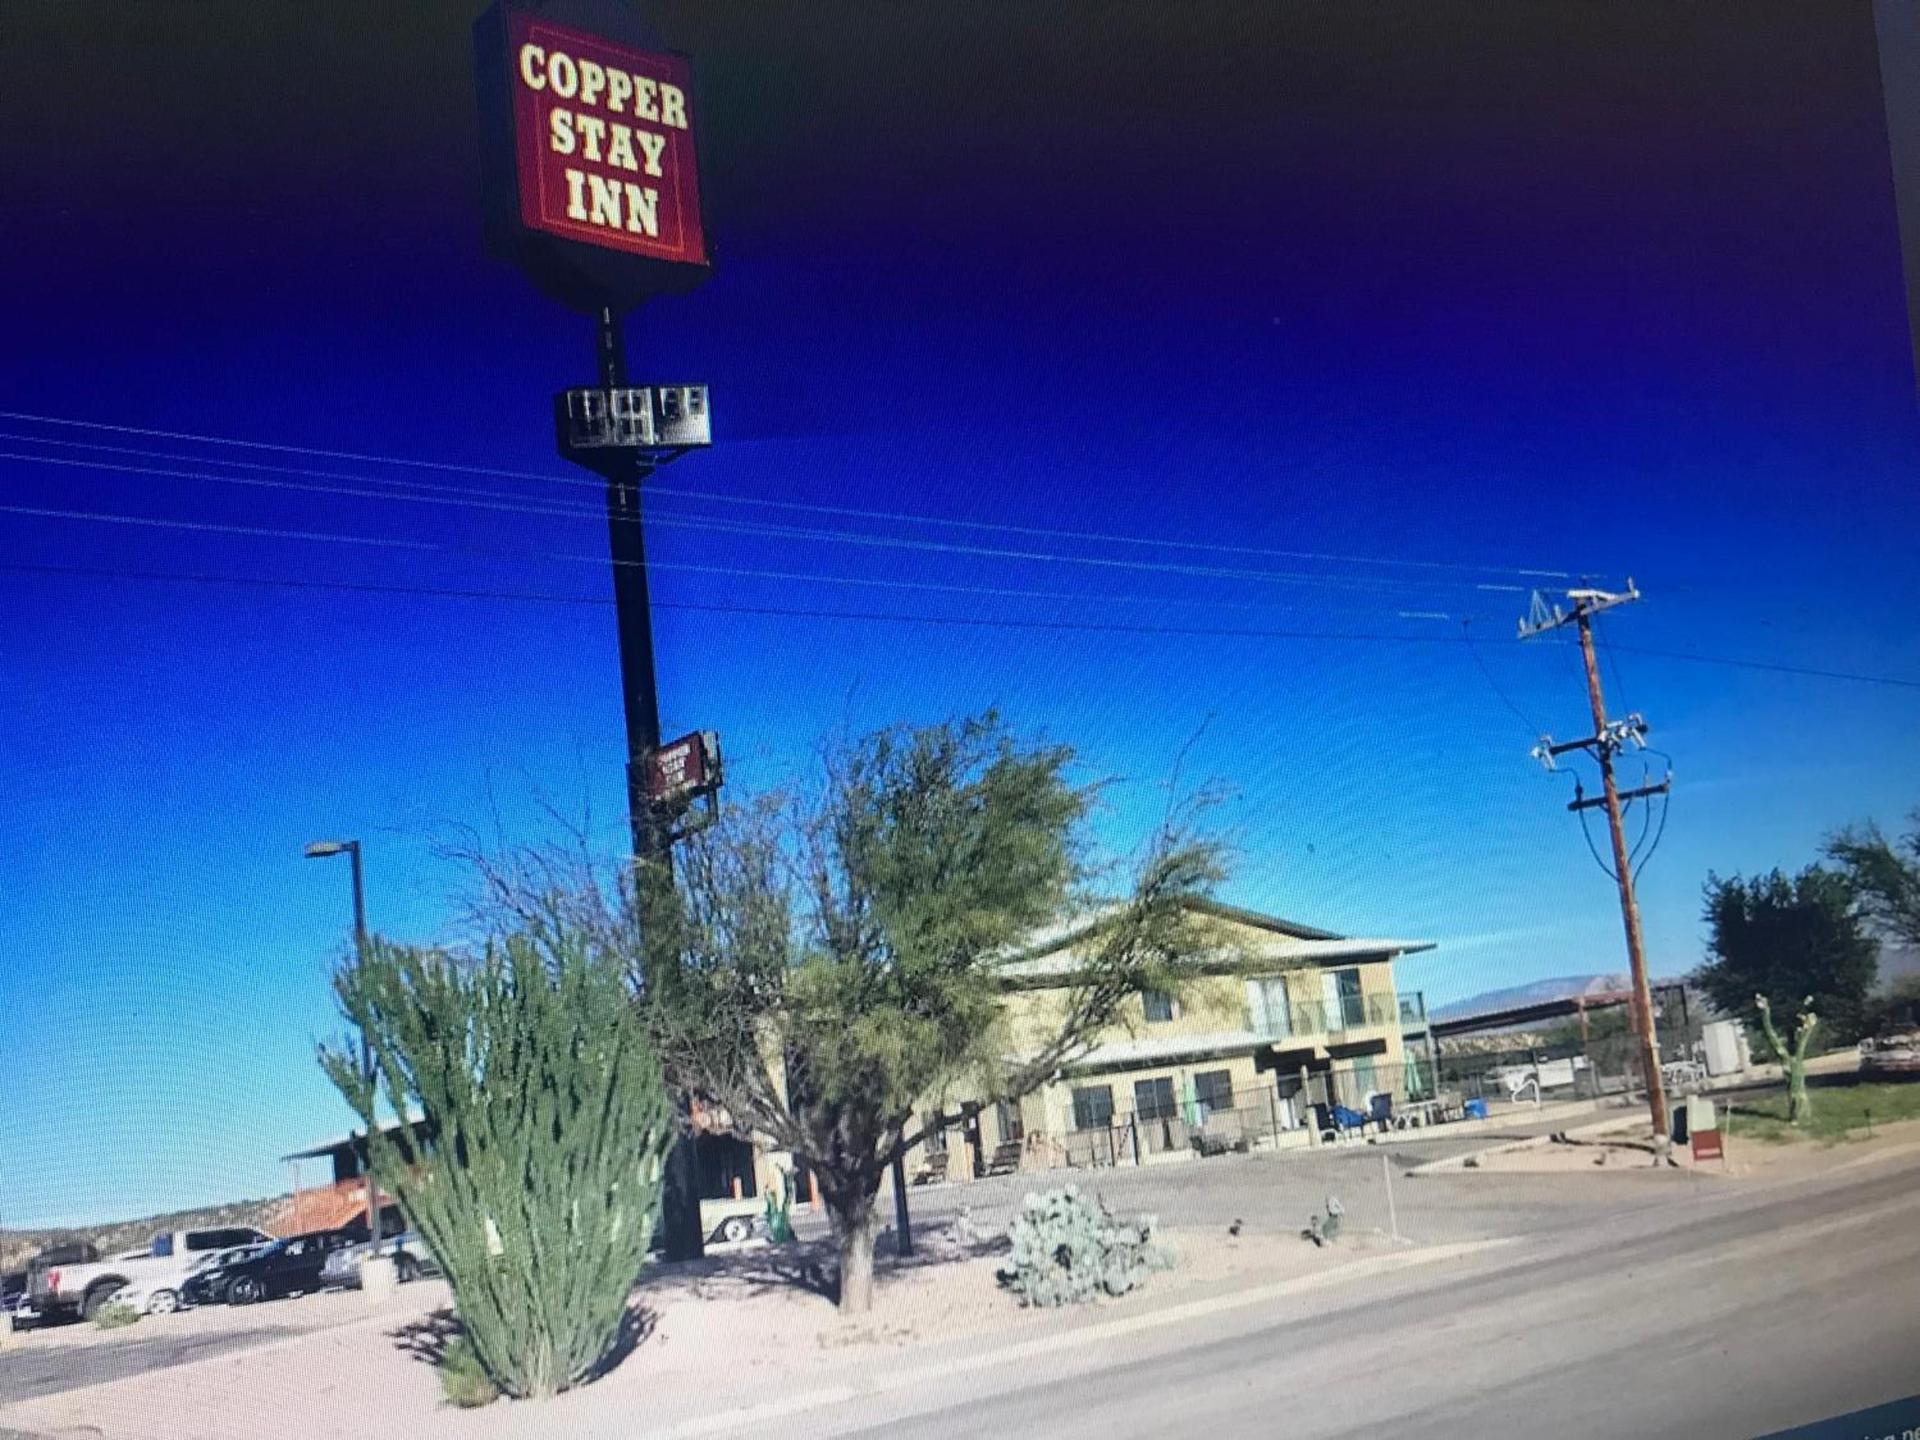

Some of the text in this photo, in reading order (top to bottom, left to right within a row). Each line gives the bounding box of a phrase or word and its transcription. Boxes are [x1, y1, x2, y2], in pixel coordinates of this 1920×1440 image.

[519, 43, 689, 130] COPPER
[549, 106, 667, 178] STAY
[564, 167, 660, 238] INN
